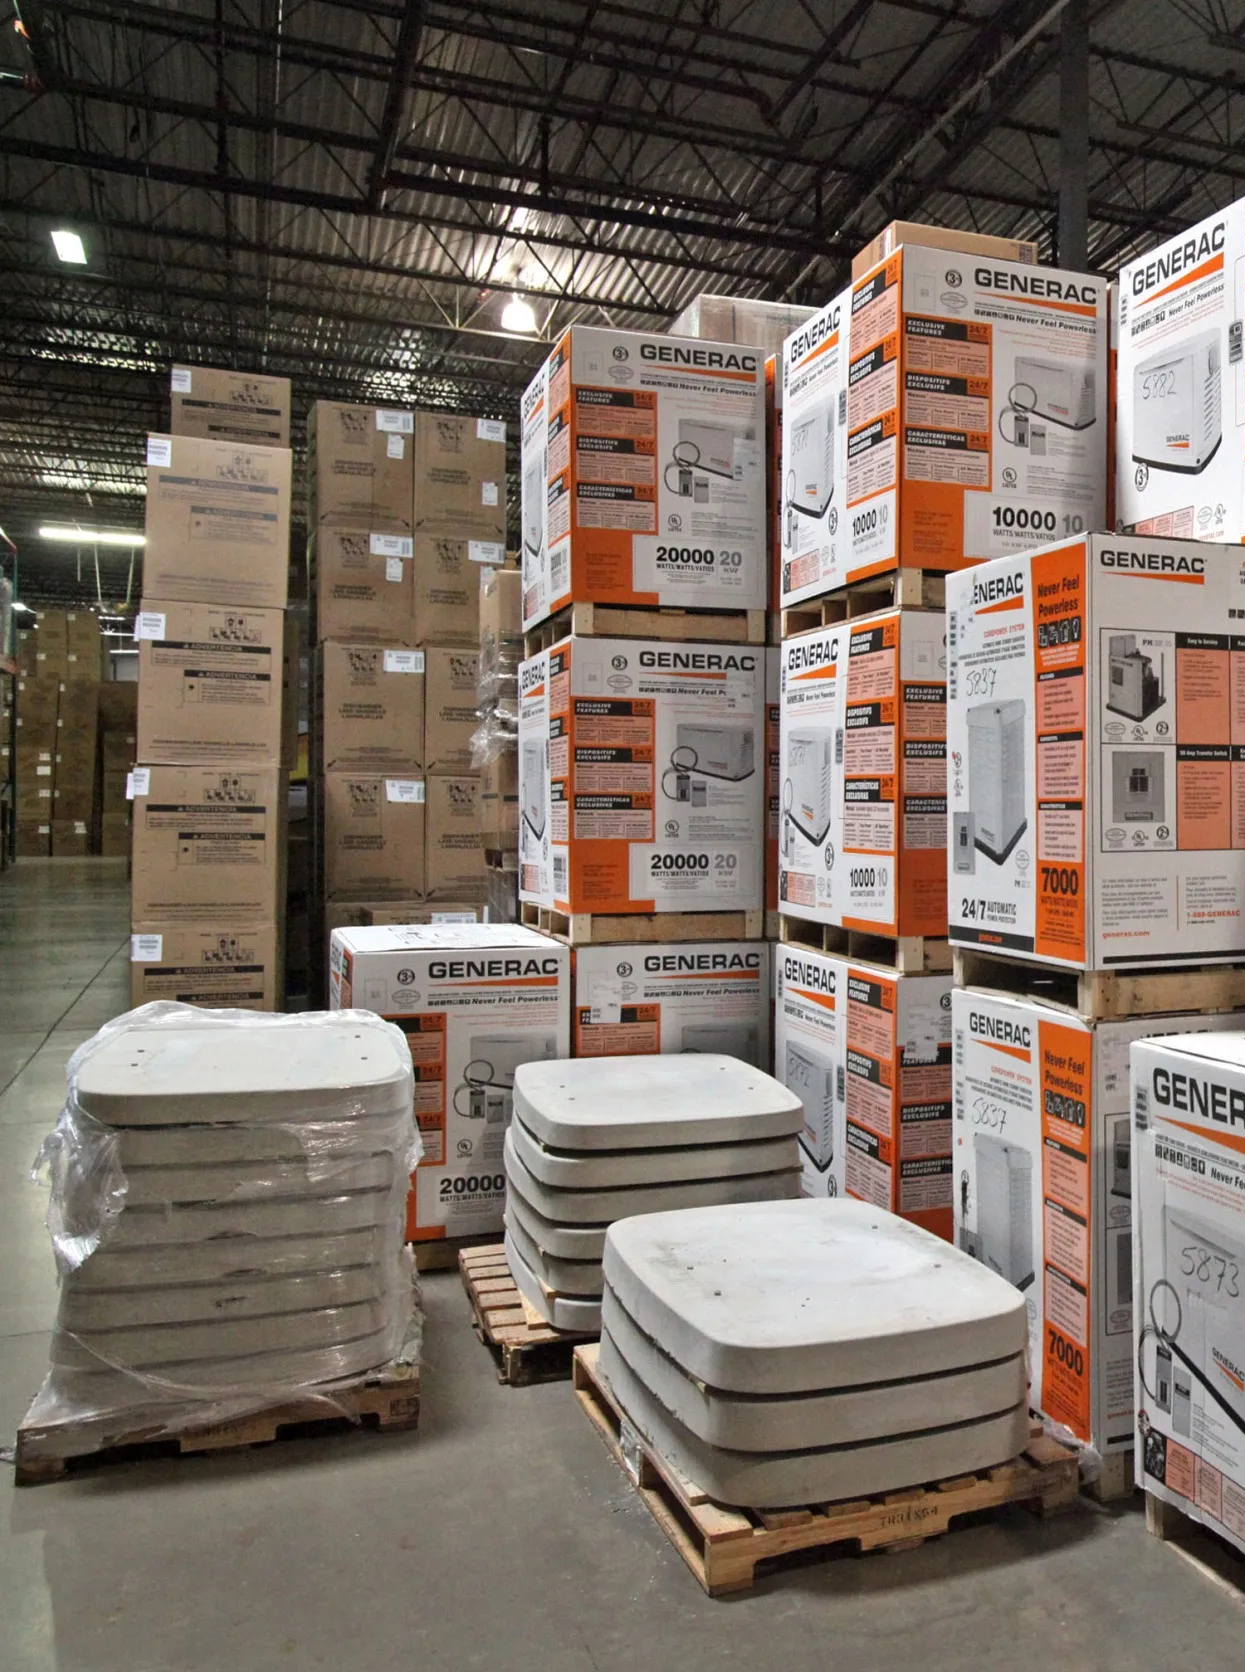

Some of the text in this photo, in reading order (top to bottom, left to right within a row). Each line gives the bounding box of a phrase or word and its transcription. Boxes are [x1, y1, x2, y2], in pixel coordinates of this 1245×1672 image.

[1132, 222, 1226, 296] GENERAC
[974, 268, 1097, 305] GENERAC
[790, 305, 841, 364] GENERAC
[640, 343, 757, 371] GENERAC
[678, 382, 699, 391] Never
[720, 386, 757, 397] Powerless
[992, 506, 1084, 534] 10000 10
[656, 546, 742, 566] 20000 20
[1099, 549, 1205, 574] GENERAC
[1037, 574, 1080, 597] Never Feel
[1038, 597, 1079, 618] Powerless
[639, 651, 756, 671] GENERAC
[788, 637, 839, 671] GENERAC
[651, 854, 737, 870] 20000 20
[1041, 867, 1079, 896] 7000
[427, 957, 559, 979] GENERAC
[643, 952, 761, 972] GENERAC
[784, 957, 836, 994] GENERAC
[969, 1012, 1031, 1047] GENERAC
[1044, 1051, 1085, 1076] Never Feel
[1044, 1070, 1084, 1096] Powerless
[439, 1175, 505, 1195] 20000
[1210, 1168, 1232, 1185] Never
[1181, 1246, 1239, 1298] 5873
[1048, 1328, 1083, 1376] 7000
